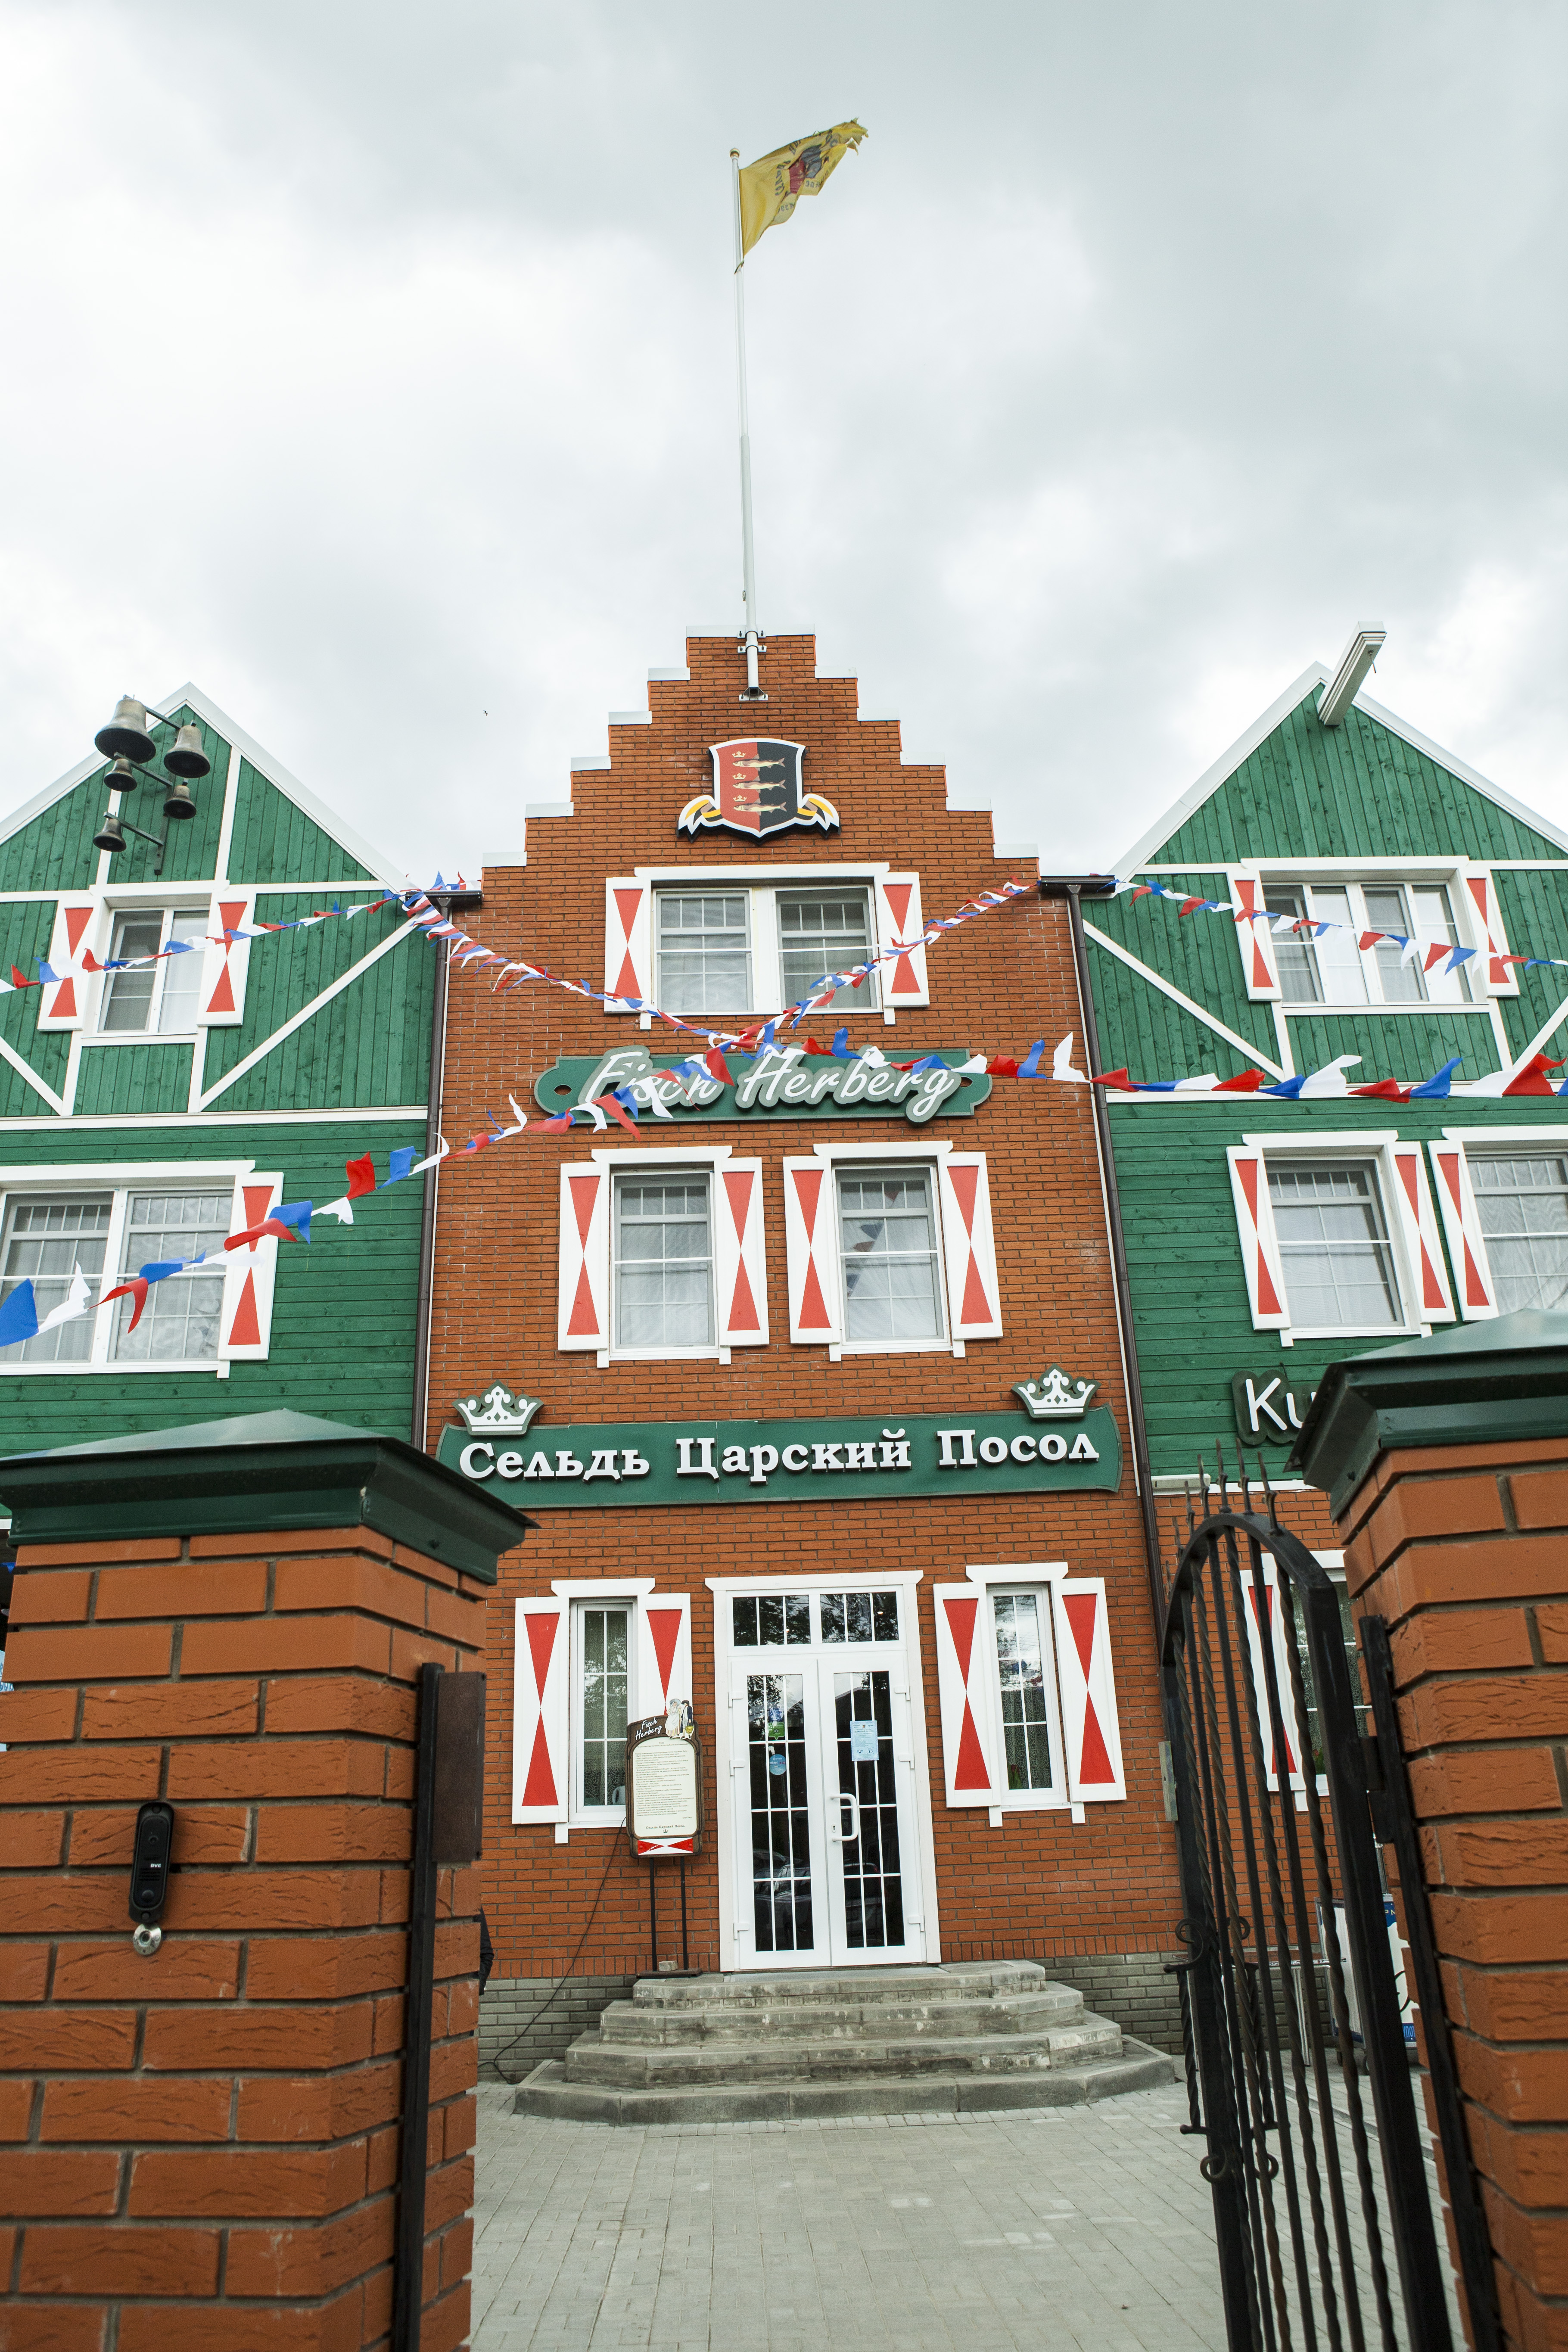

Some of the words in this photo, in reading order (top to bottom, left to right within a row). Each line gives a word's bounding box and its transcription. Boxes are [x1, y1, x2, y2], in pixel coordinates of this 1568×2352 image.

[743, 1047, 954, 1116] Herberg
[460, 1442, 650, 1481] Сельдь
[676, 1428, 912, 1482] Царский
[937, 1429, 1099, 1465] Посол
[635, 1725, 662, 1740] Herberg
[641, 1717, 657, 1730] Fisch
